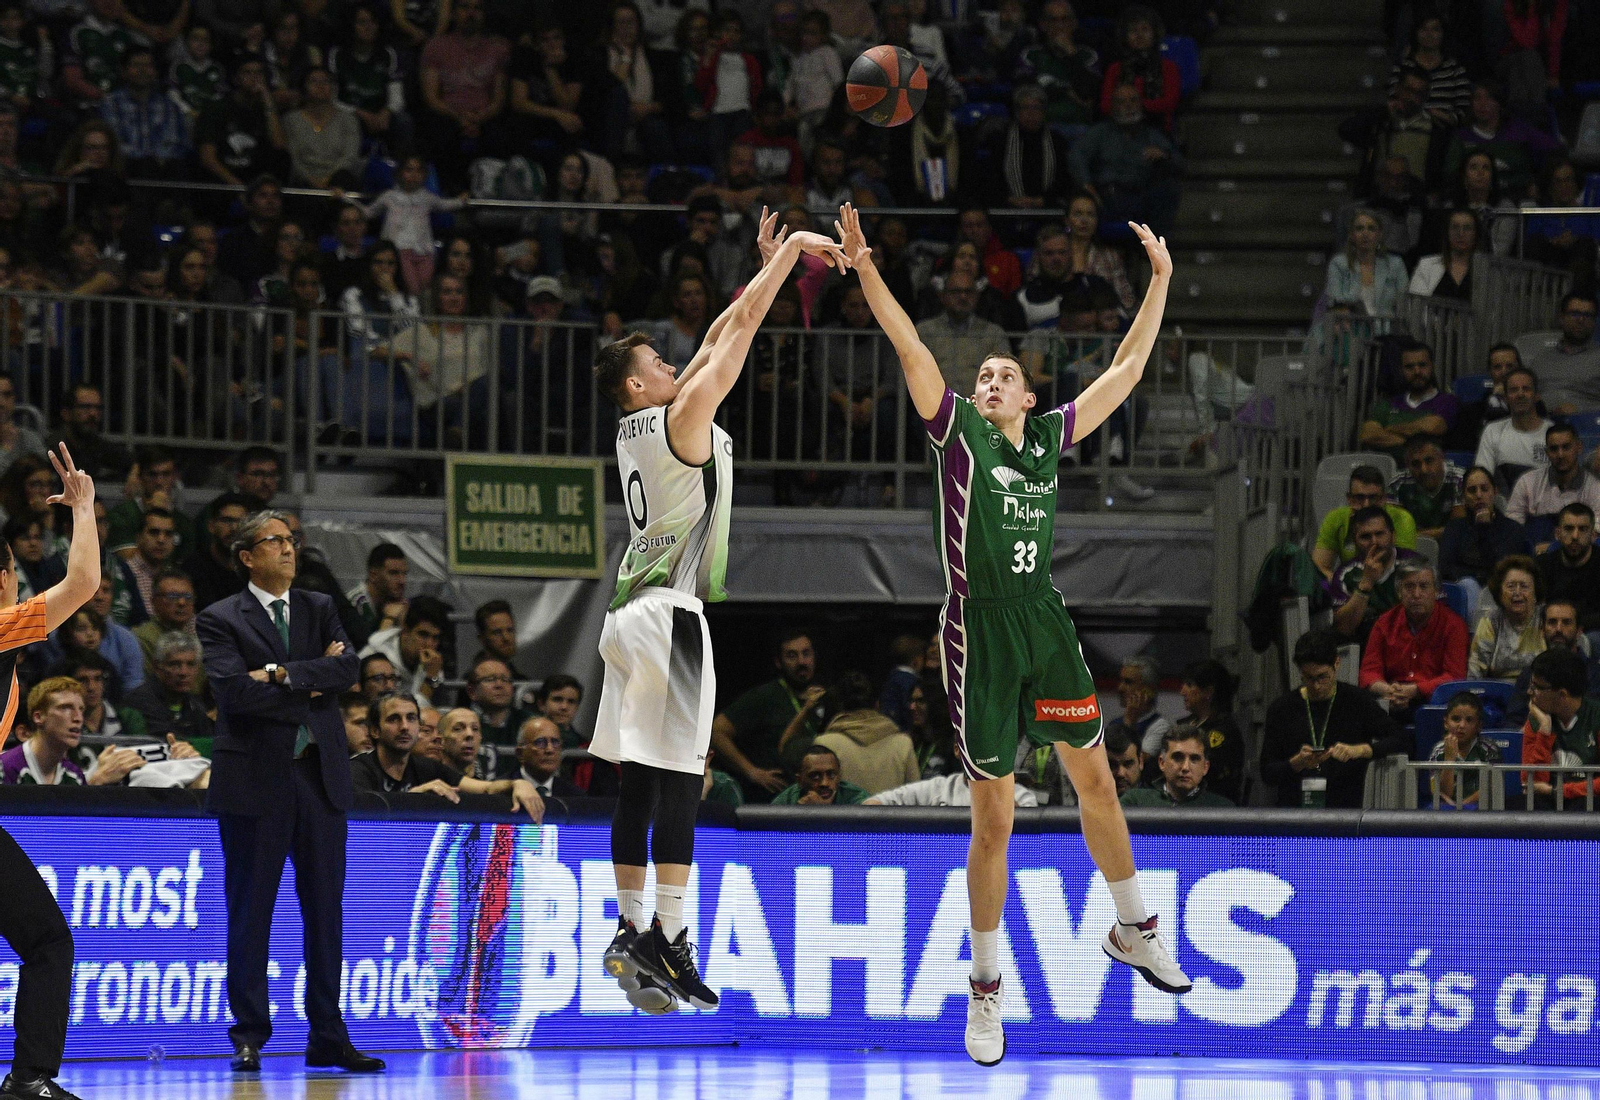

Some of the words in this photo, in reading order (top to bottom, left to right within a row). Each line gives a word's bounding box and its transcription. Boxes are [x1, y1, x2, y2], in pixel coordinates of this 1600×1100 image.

[466, 481, 542, 515] SALIDA
[557, 485, 584, 516] DE
[628, 469, 648, 531] 0
[459, 521, 593, 555] EMERGENCIA
[650, 535, 677, 548] FUTUR
[1011, 540, 1038, 573] 33
[1041, 704, 1095, 717] worten
[71, 849, 203, 929] most
[1306, 948, 1477, 1031] más
[1492, 972, 1600, 1054] ga
